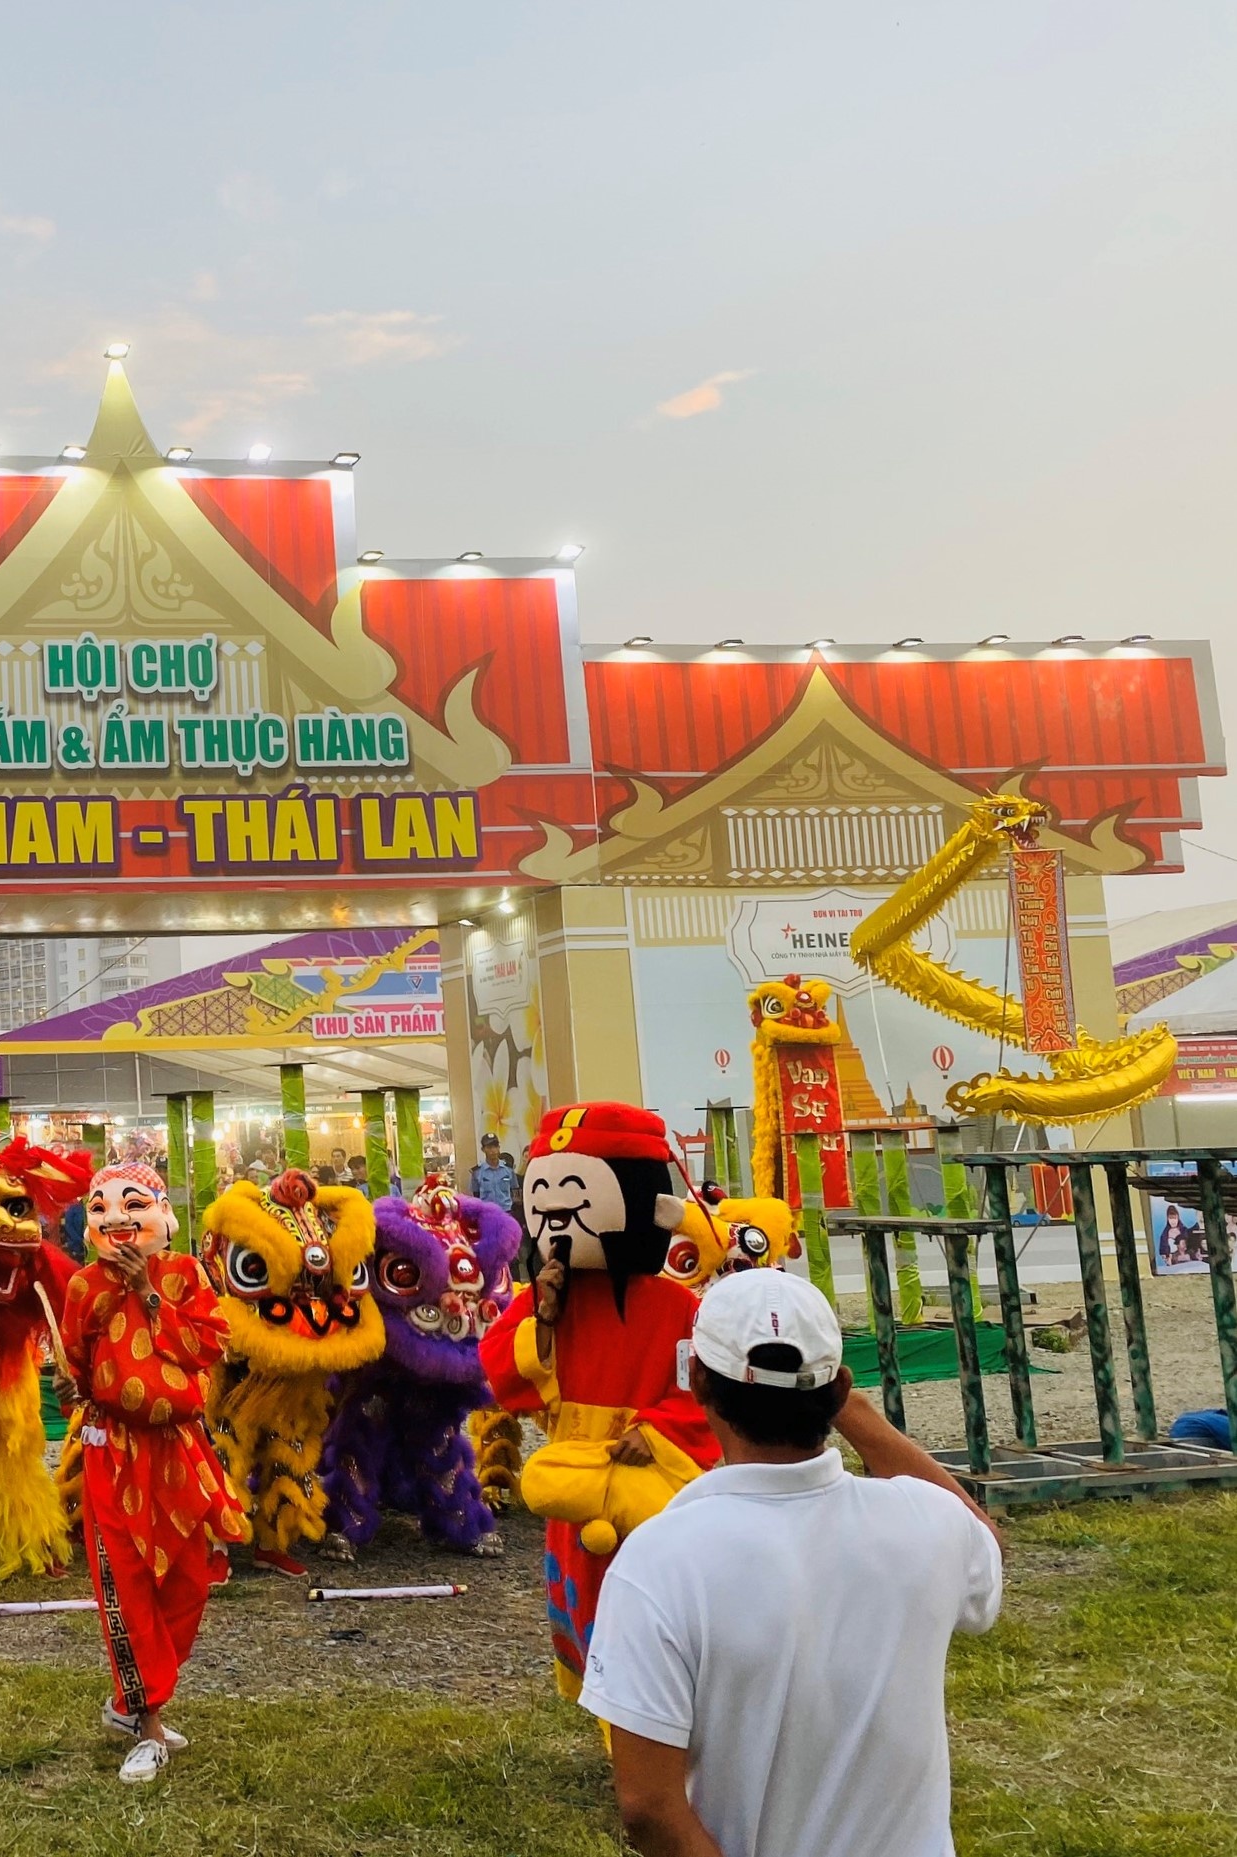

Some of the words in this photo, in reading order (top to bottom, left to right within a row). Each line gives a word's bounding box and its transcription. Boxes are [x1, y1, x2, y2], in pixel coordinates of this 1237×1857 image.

[48, 637, 116, 696] HỘI
[132, 638, 213, 696] CHỢ
[63, 726, 91, 764] &
[103, 704, 165, 763] ẨM
[178, 713, 284, 770] THỰC
[298, 712, 405, 762] HÀNG
[139, 831, 163, 843] -
[183, 789, 338, 862] THÁI
[360, 797, 478, 860] LAN
[792, 932, 852, 949] HEINE
[315, 1016, 349, 1036] KHU
[354, 1010, 386, 1034] SẢN
[390, 1003, 437, 1032] PHẨM
[786, 1060, 829, 1090] Vạn
[791, 1093, 829, 1124] Sự
